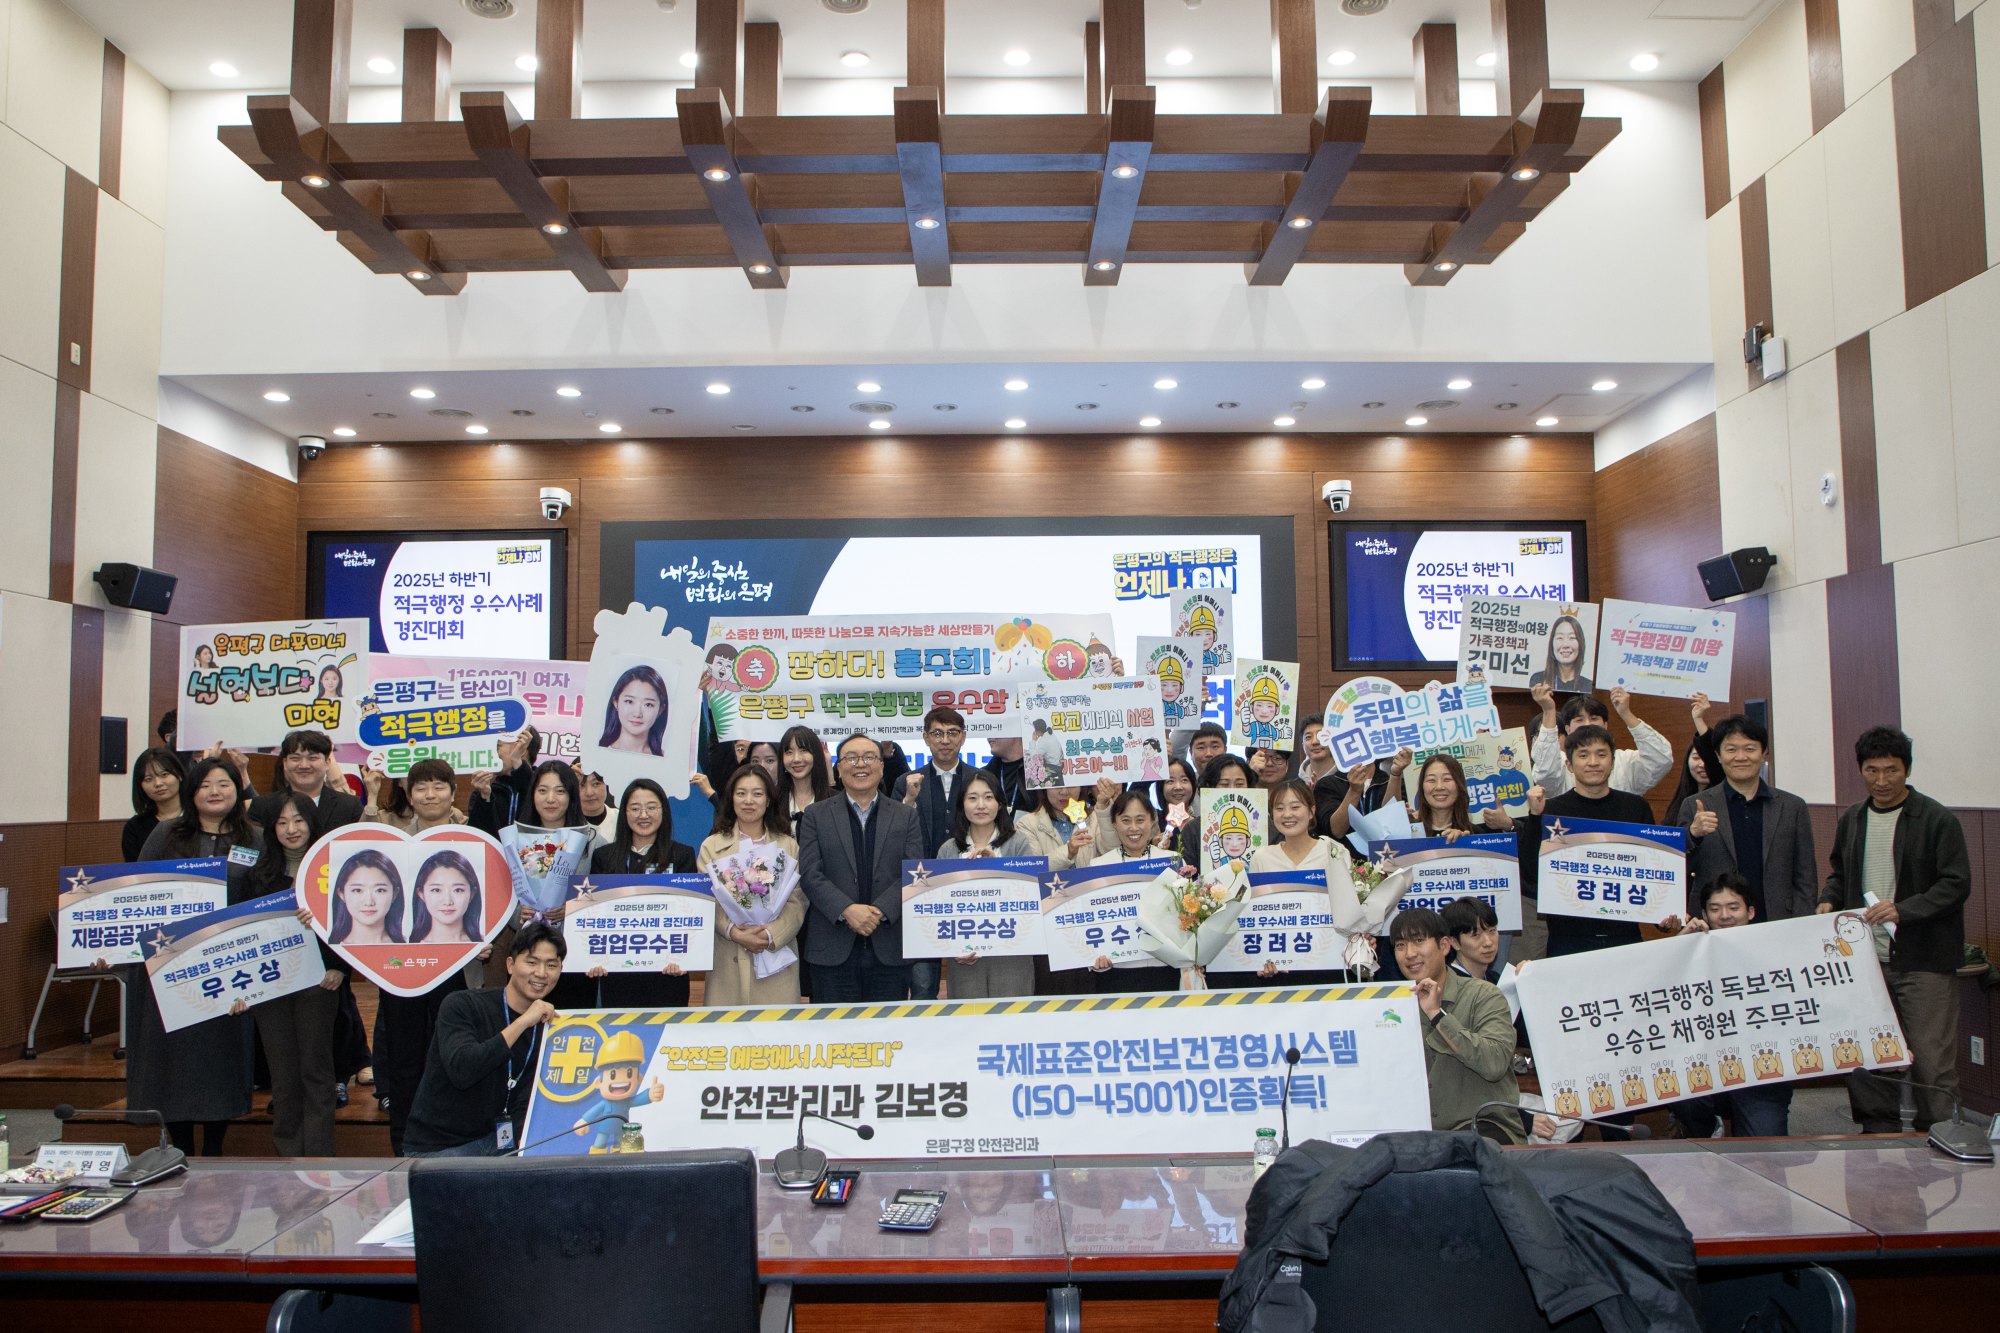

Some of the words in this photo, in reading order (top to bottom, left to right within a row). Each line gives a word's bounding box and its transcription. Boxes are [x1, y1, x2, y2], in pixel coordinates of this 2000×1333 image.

[1113, 551, 1166, 568] 은평구의
[1169, 547, 1235, 566] 적극행정은
[394, 572, 445, 587] 2025년
[449, 571, 491, 587] 하반기
[661, 556, 711, 584] 내일의
[712, 560, 749, 585] 중심
[1417, 562, 1468, 577] 2025년
[1472, 561, 1514, 577] 하반기
[686, 582, 736, 604] 변화의
[738, 582, 773, 602] 은평
[1115, 567, 1187, 600] 언제나
[1192, 566, 1236, 590] ON
[394, 594, 465, 615] 적극행정
[470, 593, 543, 613] 우수사례
[1471, 601, 1521, 617] 2025년
[394, 620, 464, 641] 경진대회
[1419, 610, 1462, 630] 경진
[725, 628, 759, 641] 소중한
[763, 628, 788, 641] 한끼,
[792, 627, 825, 640] 따뜻한
[829, 625, 874, 639] 나눔으로
[878, 624, 935, 638] 지속가능한
[938, 624, 994, 637] 세상만들기
[1469, 634, 1529, 650] 가족정책과
[1610, 628, 1687, 653] 적극행정의
[1691, 637, 1723, 657] 여왕
[214, 632, 265, 657] 은평구
[270, 631, 346, 652] 대표미녀
[745, 657, 766, 681] 축
[788, 650, 885, 680] 장하다!
[894, 647, 991, 678] 홍주희!
[1057, 650, 1076, 671] 하
[1621, 653, 1674, 669] 가족정책과
[1676, 659, 1708, 673] 김미선
[187, 663, 315, 705] 설현보다
[533, 671, 570, 689] 여자
[374, 680, 455, 704] 은평구는
[460, 679, 513, 699] 당신의
[284, 698, 341, 730] 미현
[739, 693, 815, 720] 은평구
[931, 688, 1009, 714] 우수상
[1353, 692, 1431, 728] 주민의
[1437, 684, 1489, 713] 삶을
[380, 706, 507, 740] 적극행정을
[1127, 707, 1154, 728] 사업
[1369, 711, 1499, 756] 행복하게~!
[1065, 737, 1124, 757] 최우수상
[1496, 782, 1525, 800] 실천!
[1586, 851, 1615, 860] 2025년
[1617, 853, 1637, 863] 하반기
[1419, 867, 1448, 876] 2025년
[1449, 867, 1470, 875] 하반기
[1550, 860, 1590, 874] 적극행정
[1592, 863, 1632, 878] 우수사례
[1635, 867, 1675, 882] 경진대회
[950, 889, 980, 898] 2025년
[981, 889, 1001, 897] 하반기
[1425, 879, 1465, 892] 우수사례
[1468, 878, 1509, 891] 경진대회
[113, 894, 147, 904] 2025년
[150, 892, 173, 902] 하반기
[614, 903, 645, 912] 2025년
[646, 903, 668, 911] 하반기
[914, 903, 953, 915] 적극행정
[956, 902, 996, 914] 우수사례
[1000, 900, 1039, 912] 경진대회
[1090, 896, 1119, 906] 2025년
[1120, 893, 1141, 902] 하반기
[1252, 903, 1281, 912] 2025년
[71, 907, 118, 922] 적극행정
[121, 904, 167, 920] 우수사례
[170, 901, 215, 916] 경진대회
[1055, 911, 1095, 926] 적극행정
[1097, 906, 1137, 920] 우수사례
[1258, 916, 1297, 927] 우수사례
[576, 917, 616, 929] 적극행정
[619, 916, 660, 928] 우수사례
[663, 916, 704, 928] 경진대회
[937, 918, 1016, 940] 최우수상
[71, 922, 164, 949] 지방공공
[202, 940, 235, 957] 2025년
[235, 933, 260, 947] 하반기
[588, 933, 689, 955] 협업우수팀
[1085, 924, 1141, 948] 우수
[163, 963, 211, 984] 적극행정
[212, 947, 259, 970] 우수사례
[260, 933, 305, 956] 경진대회
[1559, 998, 1624, 1032] 은평구
[1630, 981, 1714, 1019] 적극행정
[1720, 968, 1793, 1002] 독보적
[1801, 961, 1854, 989] 1위!!
[1605, 1023, 1667, 1057] 우승은
[1671, 1010, 1738, 1044] 채형원
[1745, 999, 1820, 1031] 주무관
[730, 1043, 810, 1071] 예방에서
[976, 1029, 1360, 1077] 국제표준안전보건경영시스템
[700, 1084, 865, 1121] 안전관리과
[875, 1081, 969, 1119] 김보경
[1012, 1075, 1329, 1118] (ISO-45001)인증획득!
[926, 1138, 976, 1154] 은평구청
[977, 1136, 1040, 1153] 안전관리과
